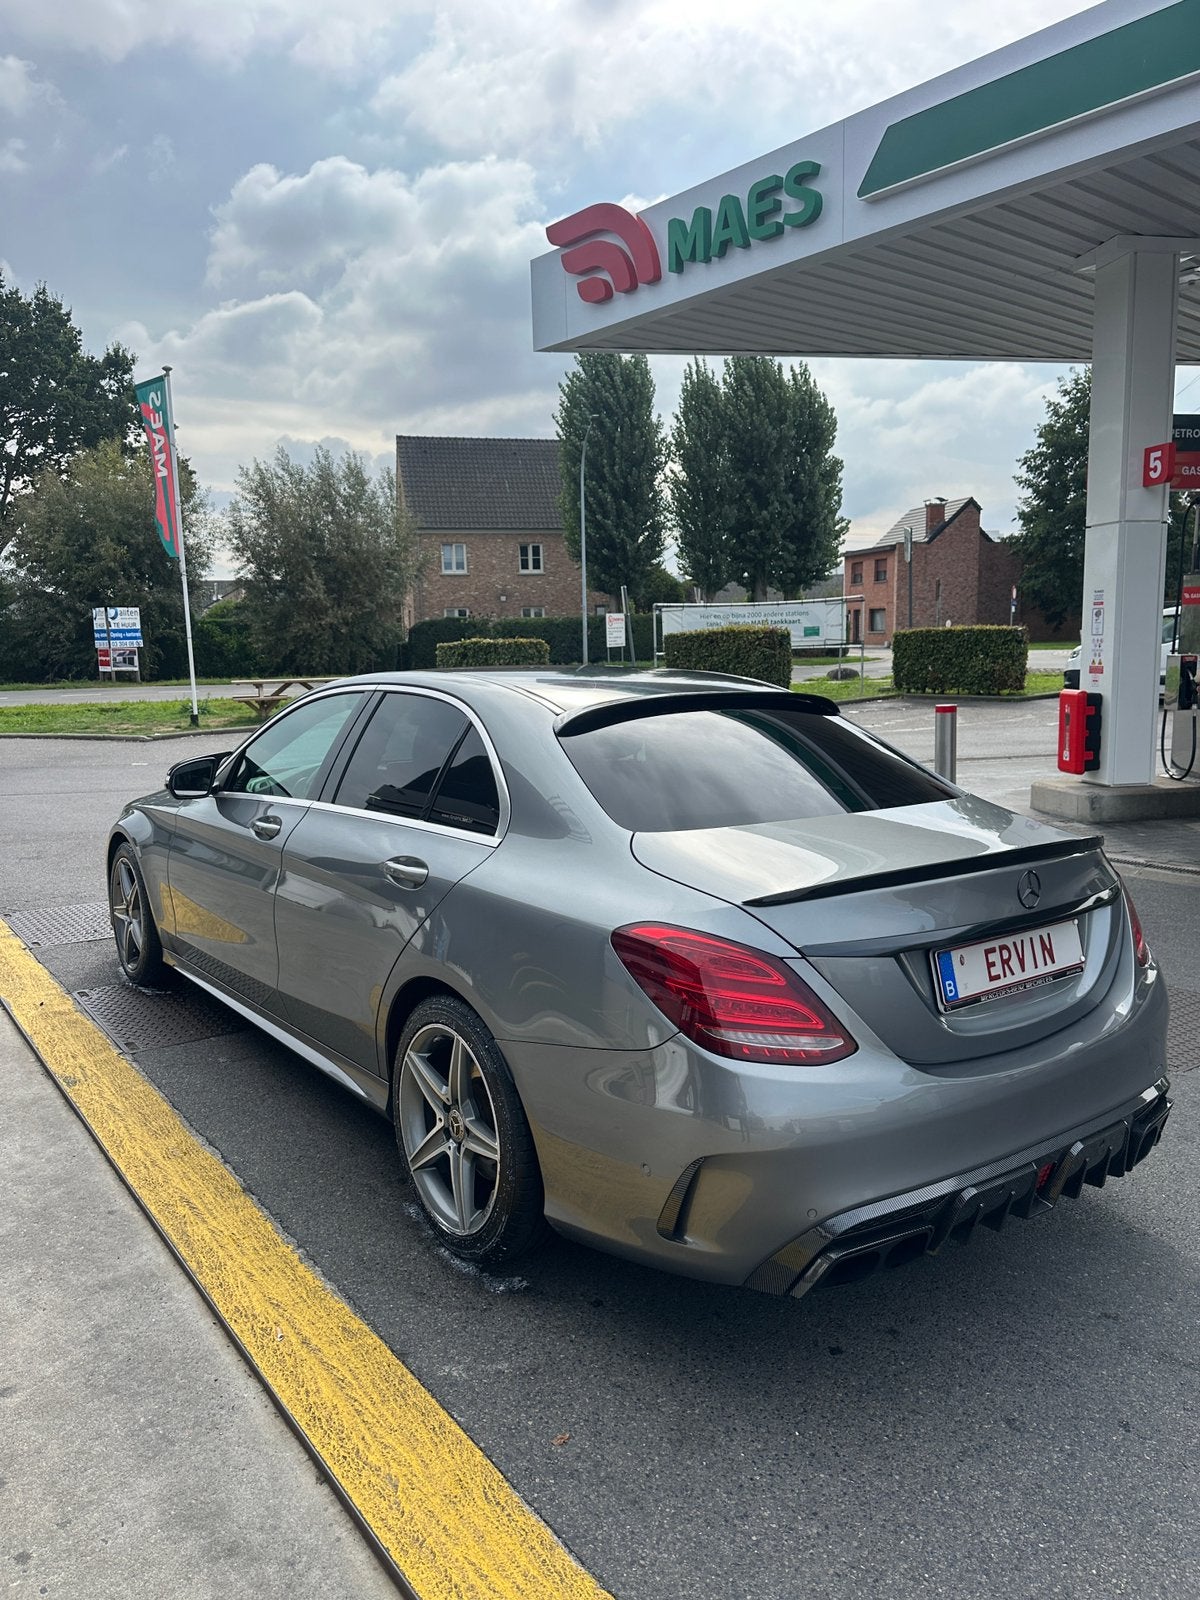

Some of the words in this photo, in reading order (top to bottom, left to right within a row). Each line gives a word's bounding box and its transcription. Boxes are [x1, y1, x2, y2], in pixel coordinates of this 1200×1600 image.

[668, 160, 823, 273] MAES
[1149, 450, 1162, 478] 5
[731, 612, 746, 621] bijna
[984, 933, 1056, 982] ERVIN
[945, 981, 955, 996] B
